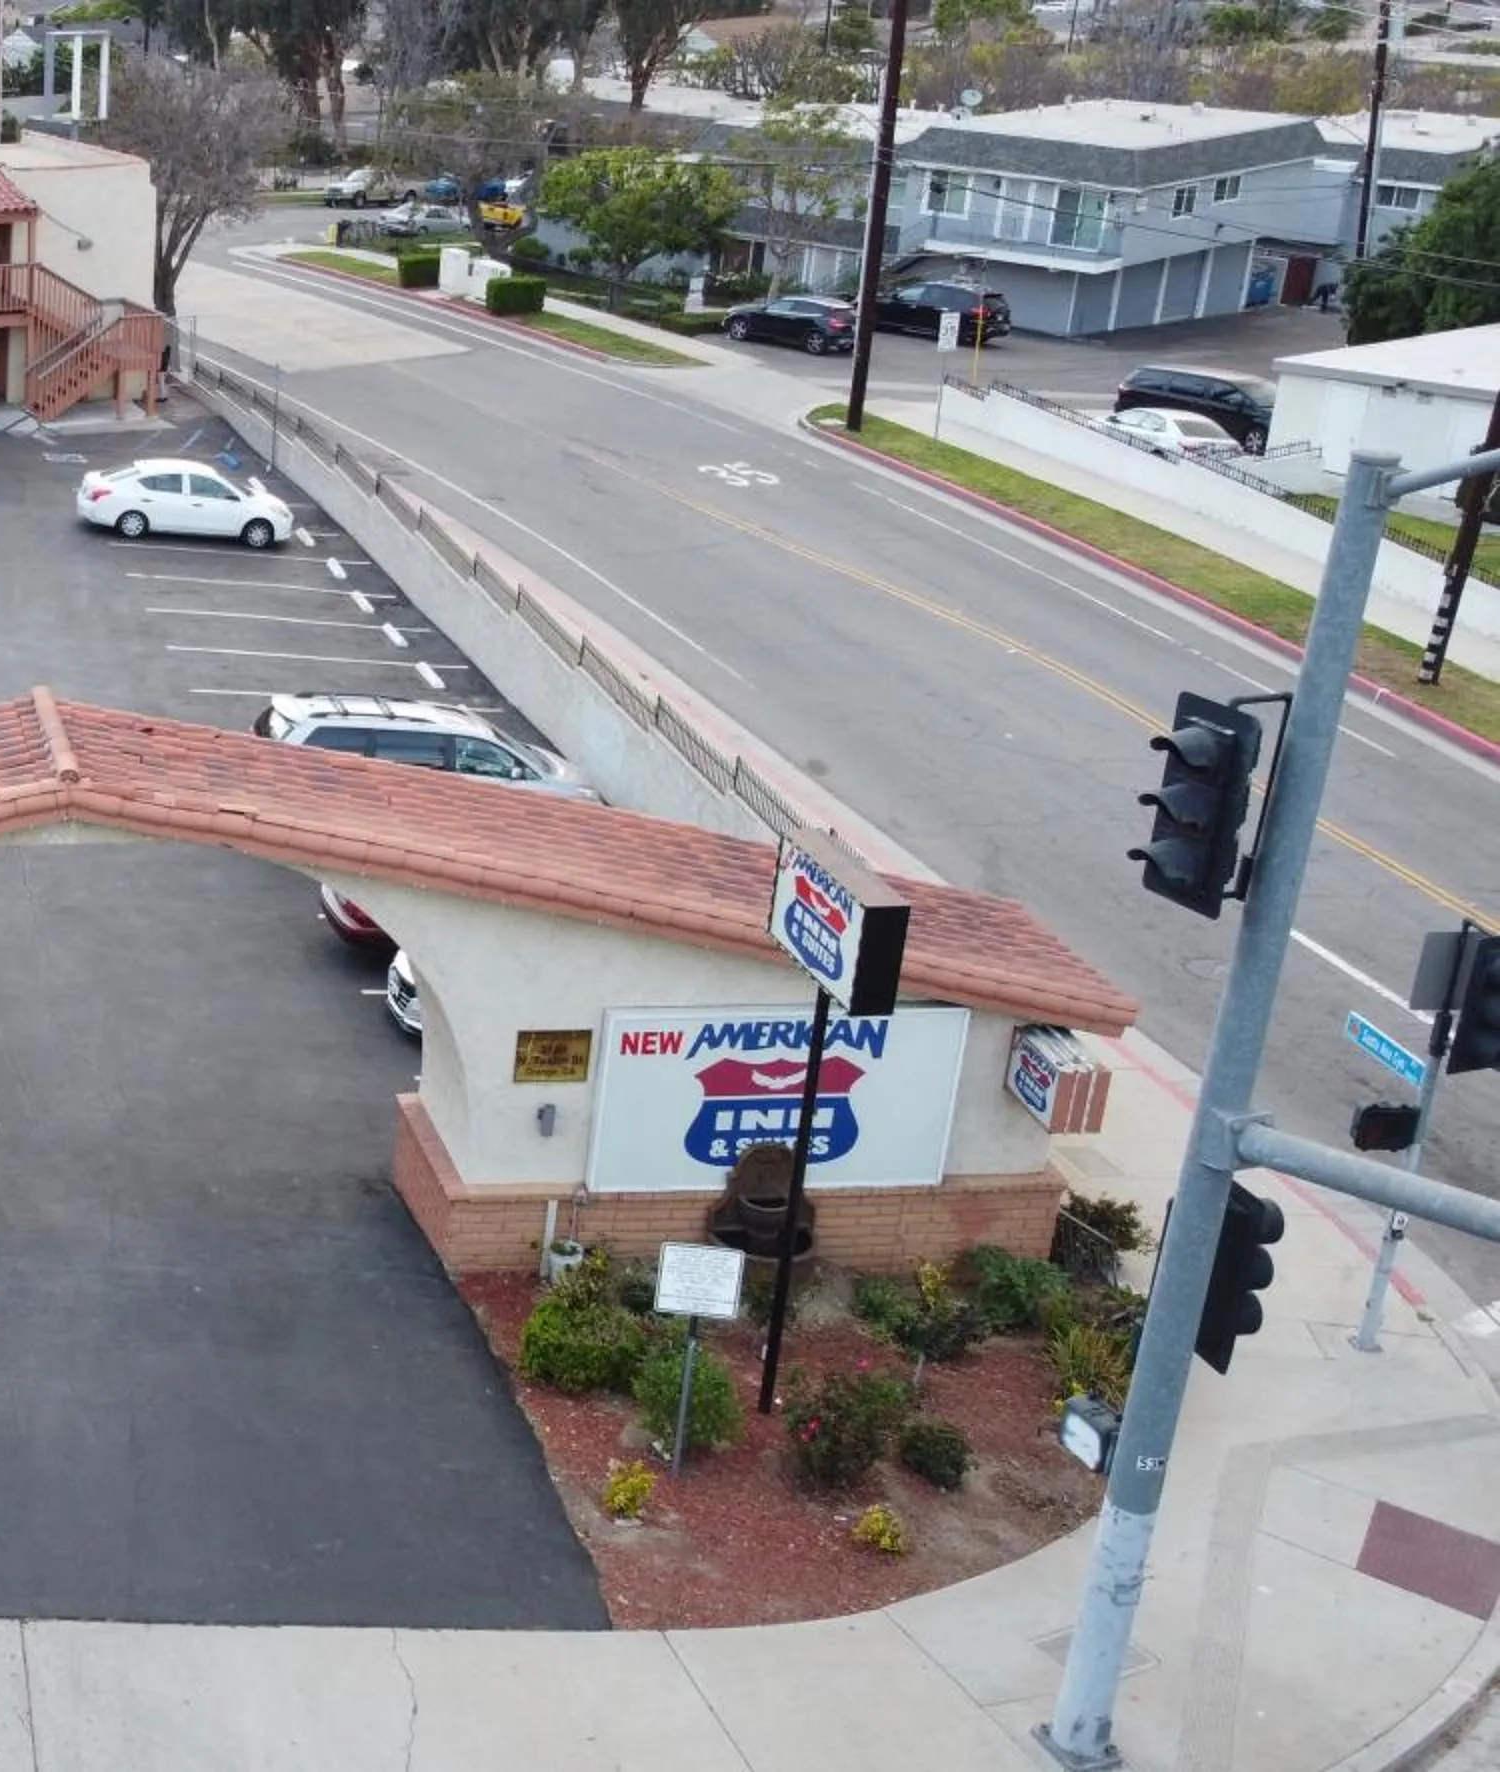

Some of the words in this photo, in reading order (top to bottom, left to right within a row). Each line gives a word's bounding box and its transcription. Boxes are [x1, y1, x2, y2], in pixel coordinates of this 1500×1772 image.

[794, 903, 838, 956] INN
[620, 1031, 683, 1056] NEW
[685, 1019, 890, 1060] AMERIAN
[715, 1107, 835, 1131] INN
[709, 1138, 729, 1158] &
